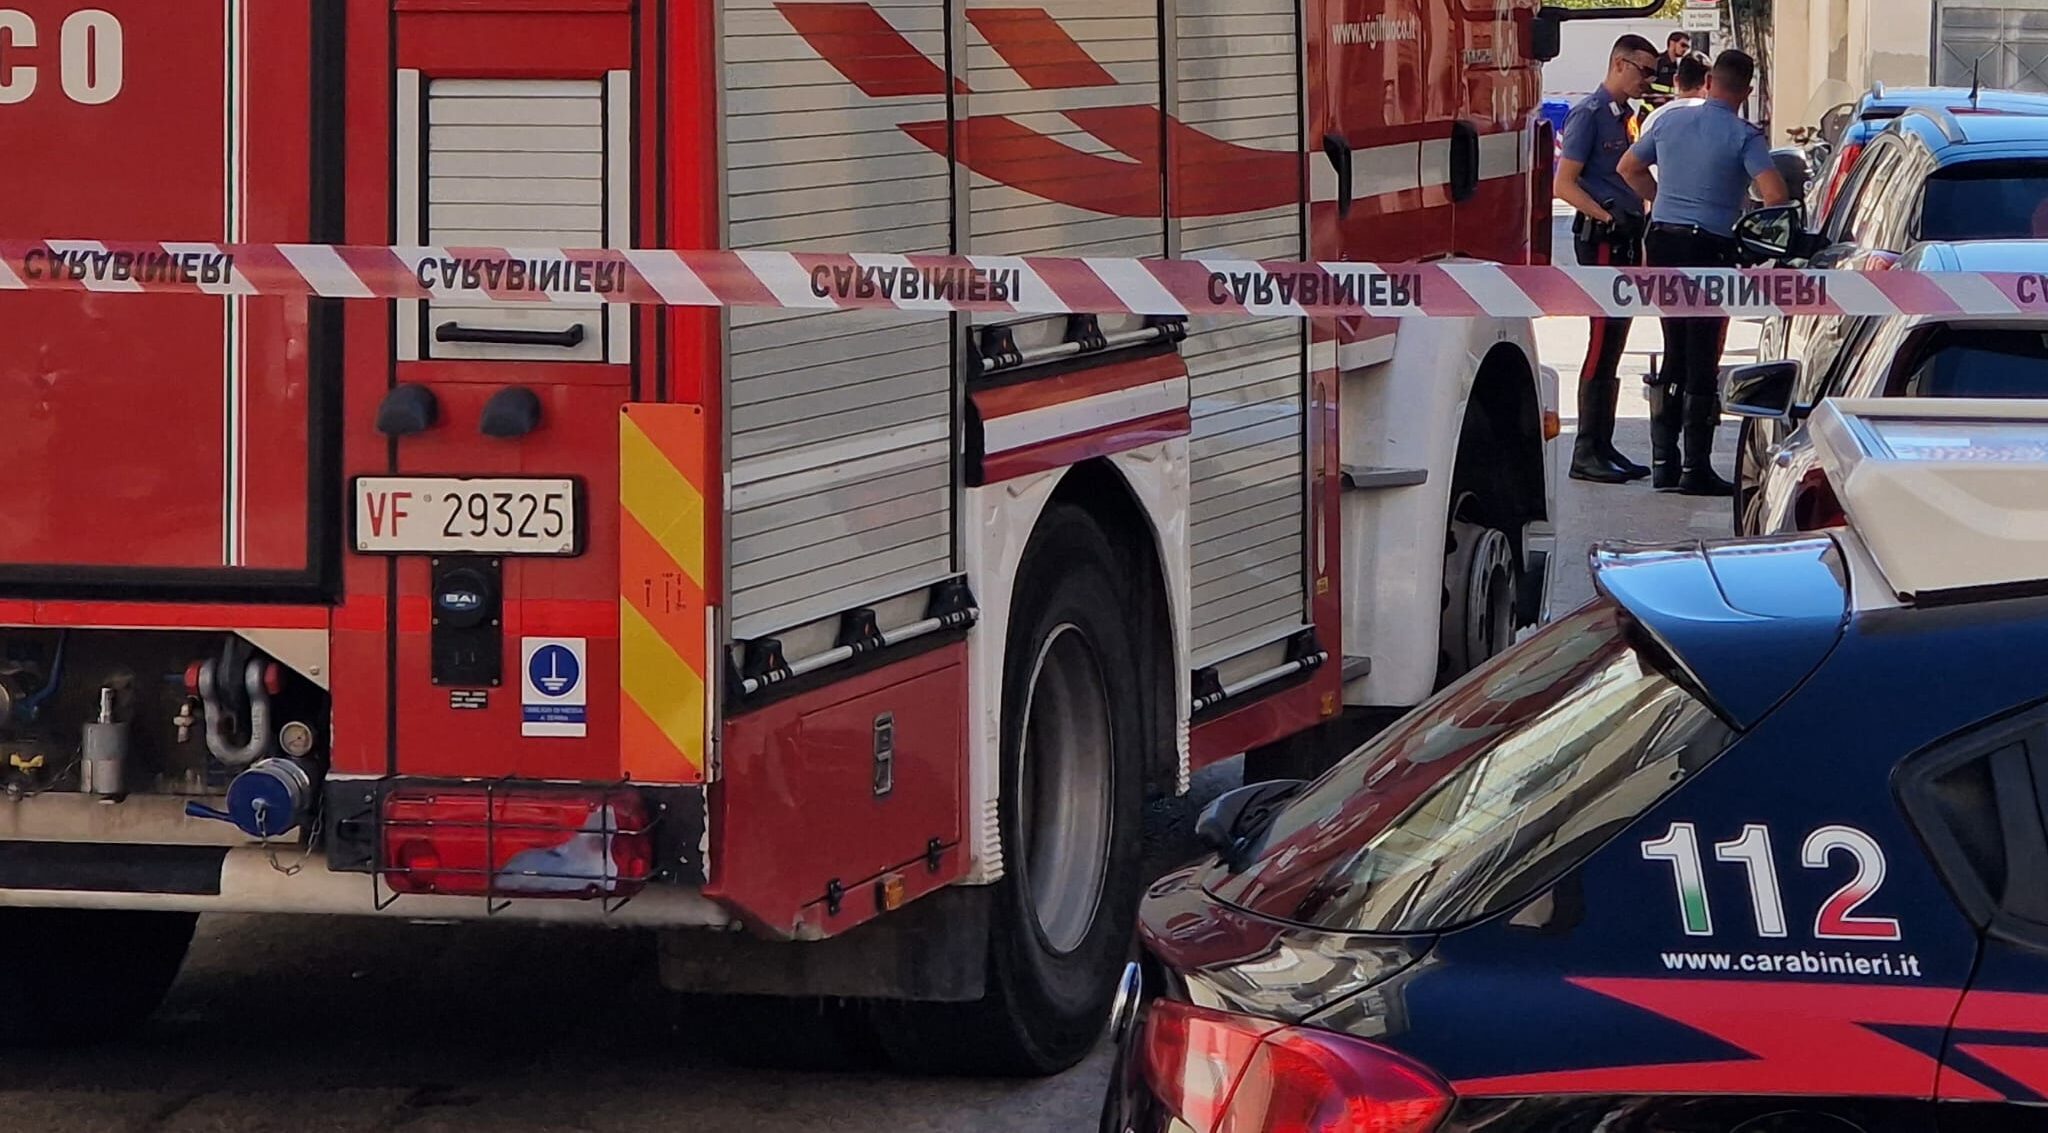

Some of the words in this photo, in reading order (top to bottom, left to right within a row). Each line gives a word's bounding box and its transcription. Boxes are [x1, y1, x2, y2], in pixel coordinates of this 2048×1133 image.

[366, 492, 412, 537] VF
[443, 492, 563, 538] 29325
[445, 594, 476, 603] BAI
[1641, 822, 1901, 940] 112
[1661, 950, 1922, 977] www.carabinieri.it
